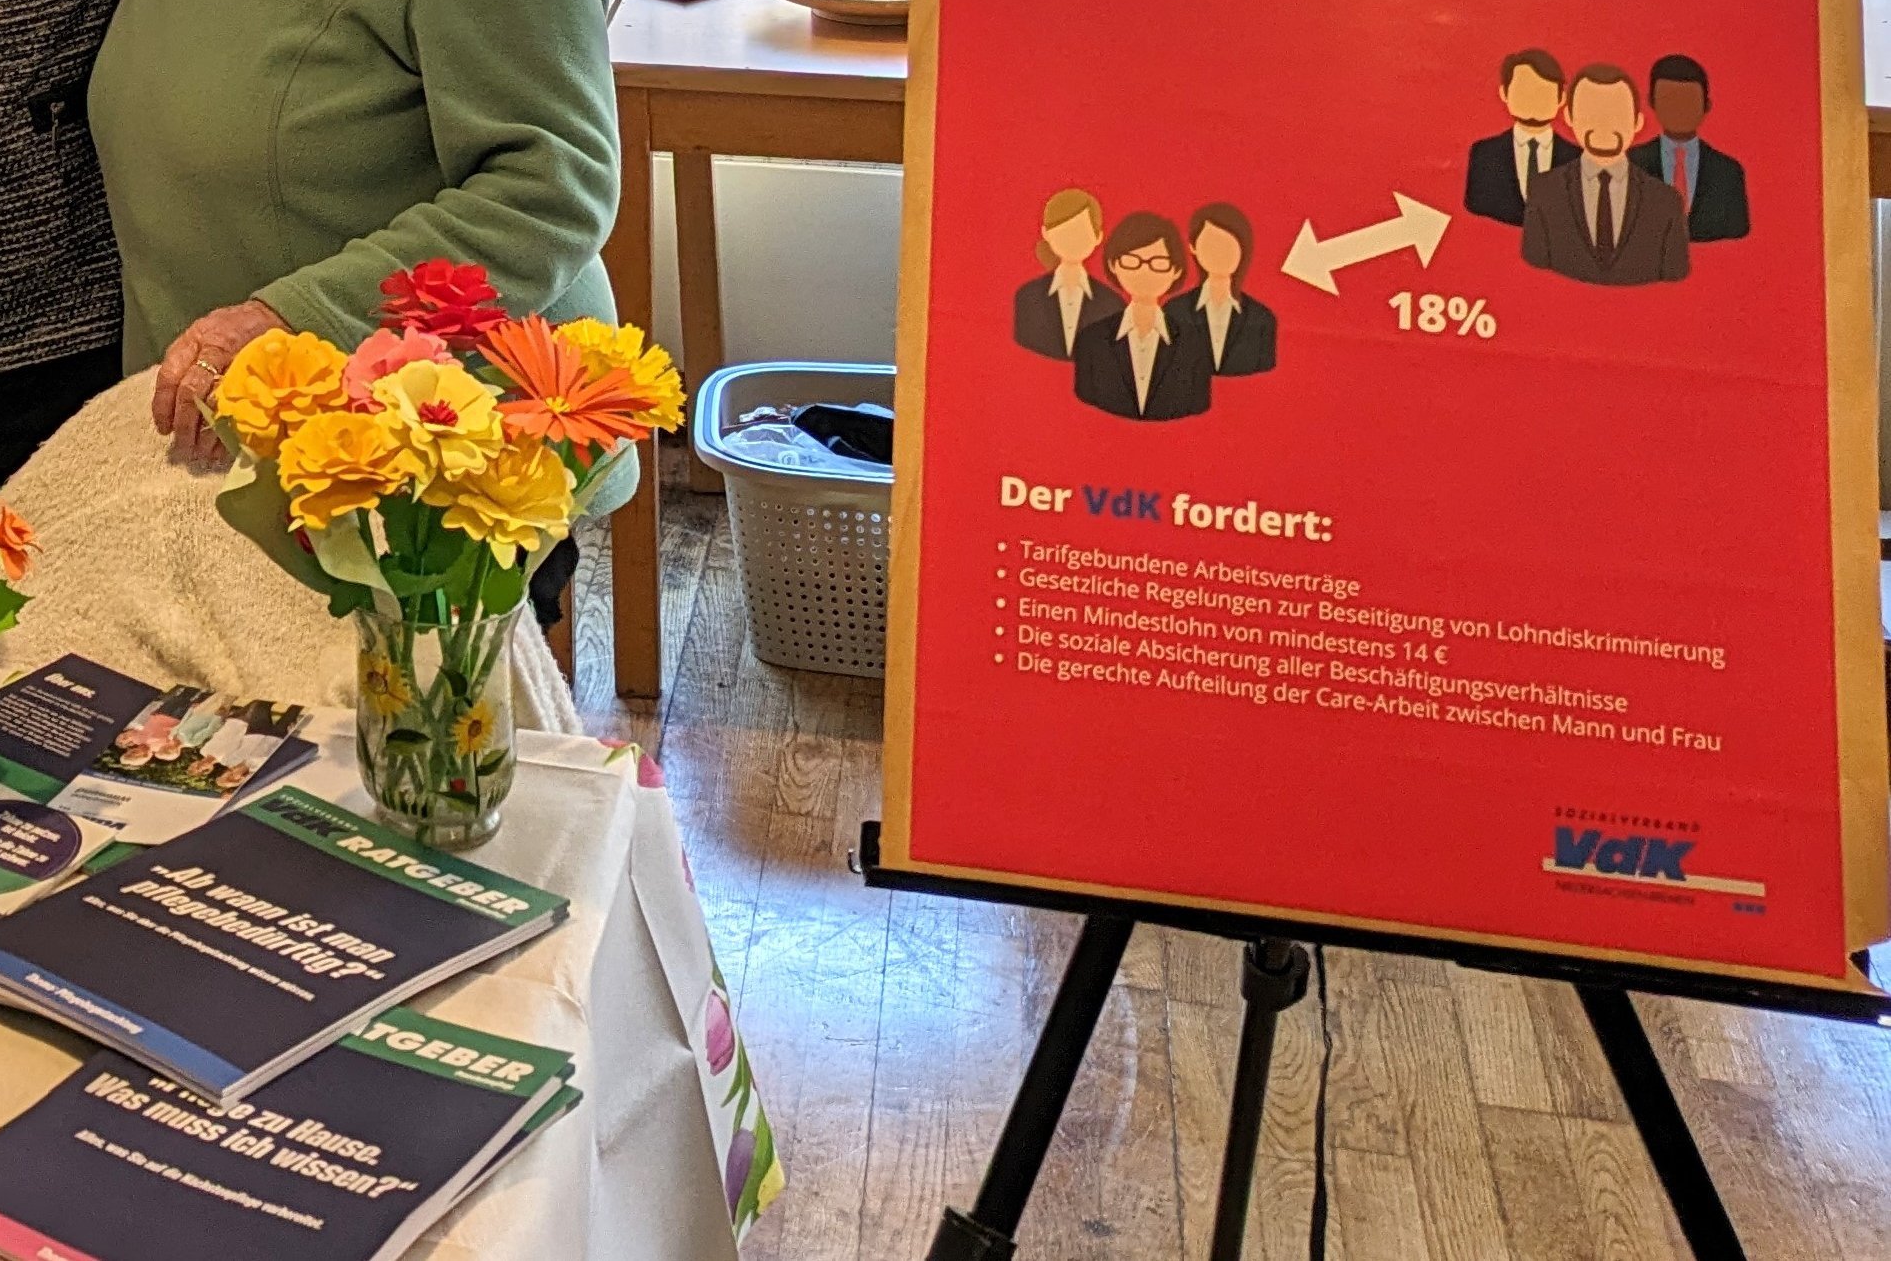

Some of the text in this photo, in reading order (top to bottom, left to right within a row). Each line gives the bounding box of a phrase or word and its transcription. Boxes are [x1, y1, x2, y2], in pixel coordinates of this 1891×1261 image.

[1388, 291, 1497, 339] 18%
[1000, 476, 1334, 542] Der VdK fordert:
[1019, 540, 1361, 600] Tarifgebundene Arbeitsverträge
[1019, 567, 1726, 670] Gesetzliche Regelungen zur Beseitigung von Lohndiskriminierung
[1019, 597, 1450, 666] Einen Mindestlohn von mindestens 14 €
[1017, 651, 1721, 752] Die gerechte Aufteilung der Care-Arbeit zwischen Mann und Frau
[1018, 624, 1629, 713] Die soziale Absicherung aller Beschäftigungsverhältnisse
[260, 797, 530, 915] VdK RATGEBER
[1554, 825, 1698, 881] VdK
[205, 884, 290, 920] wann
[277, 912, 336, 938] ist
[320, 931, 397, 964] man
[356, 1021, 535, 1083] TGEBER
[83, 1072, 151, 1111] Was
[141, 1100, 228, 1141] muss
[219, 1127, 276, 1159] ich
[247, 1108, 380, 1166] zu Hause.
